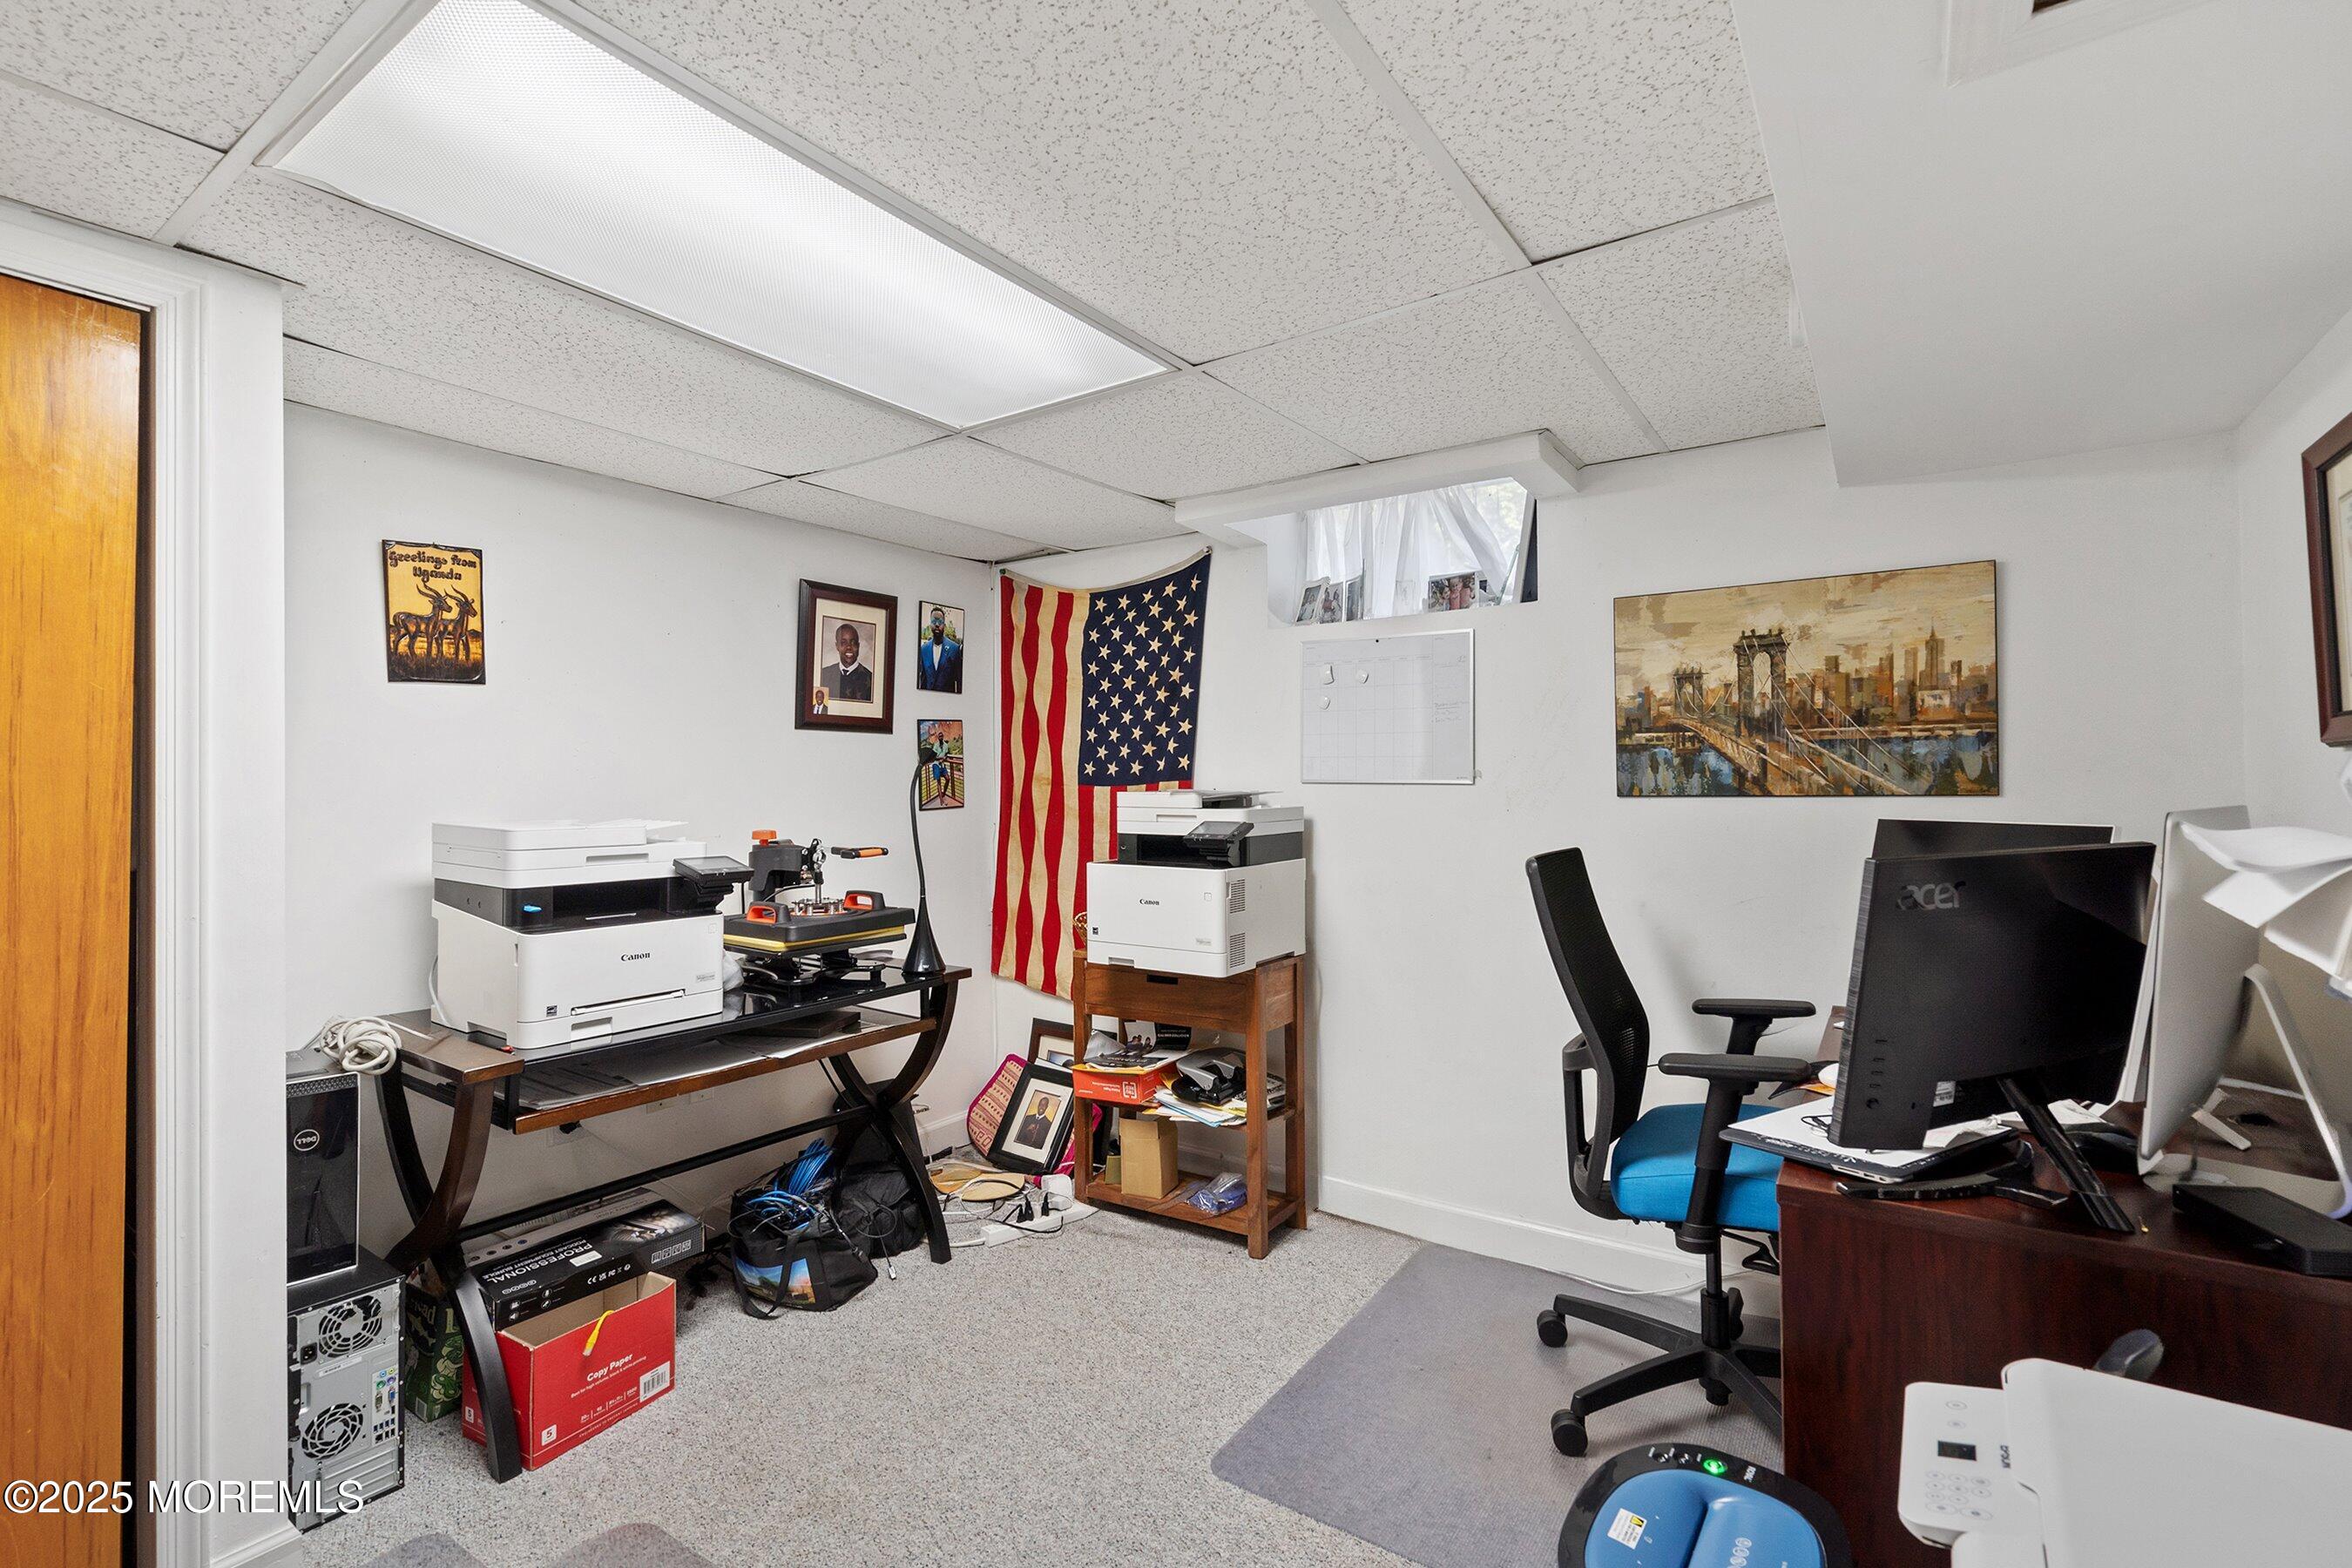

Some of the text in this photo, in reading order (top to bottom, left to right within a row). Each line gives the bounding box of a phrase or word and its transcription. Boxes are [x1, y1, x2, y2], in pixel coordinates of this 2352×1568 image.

[389, 551, 476, 569] Greetings from
[413, 566, 463, 583] Uganda
[1139, 897, 1160, 906] Canon
[1896, 881, 1966, 911] acer
[620, 951, 651, 962] Canon
[296, 1135, 317, 1145] DELL
[487, 1242, 592, 1283] PROFESSIONAL
[585, 1354, 633, 1382] Copy Paper
[546, 1429, 552, 1438] 5
